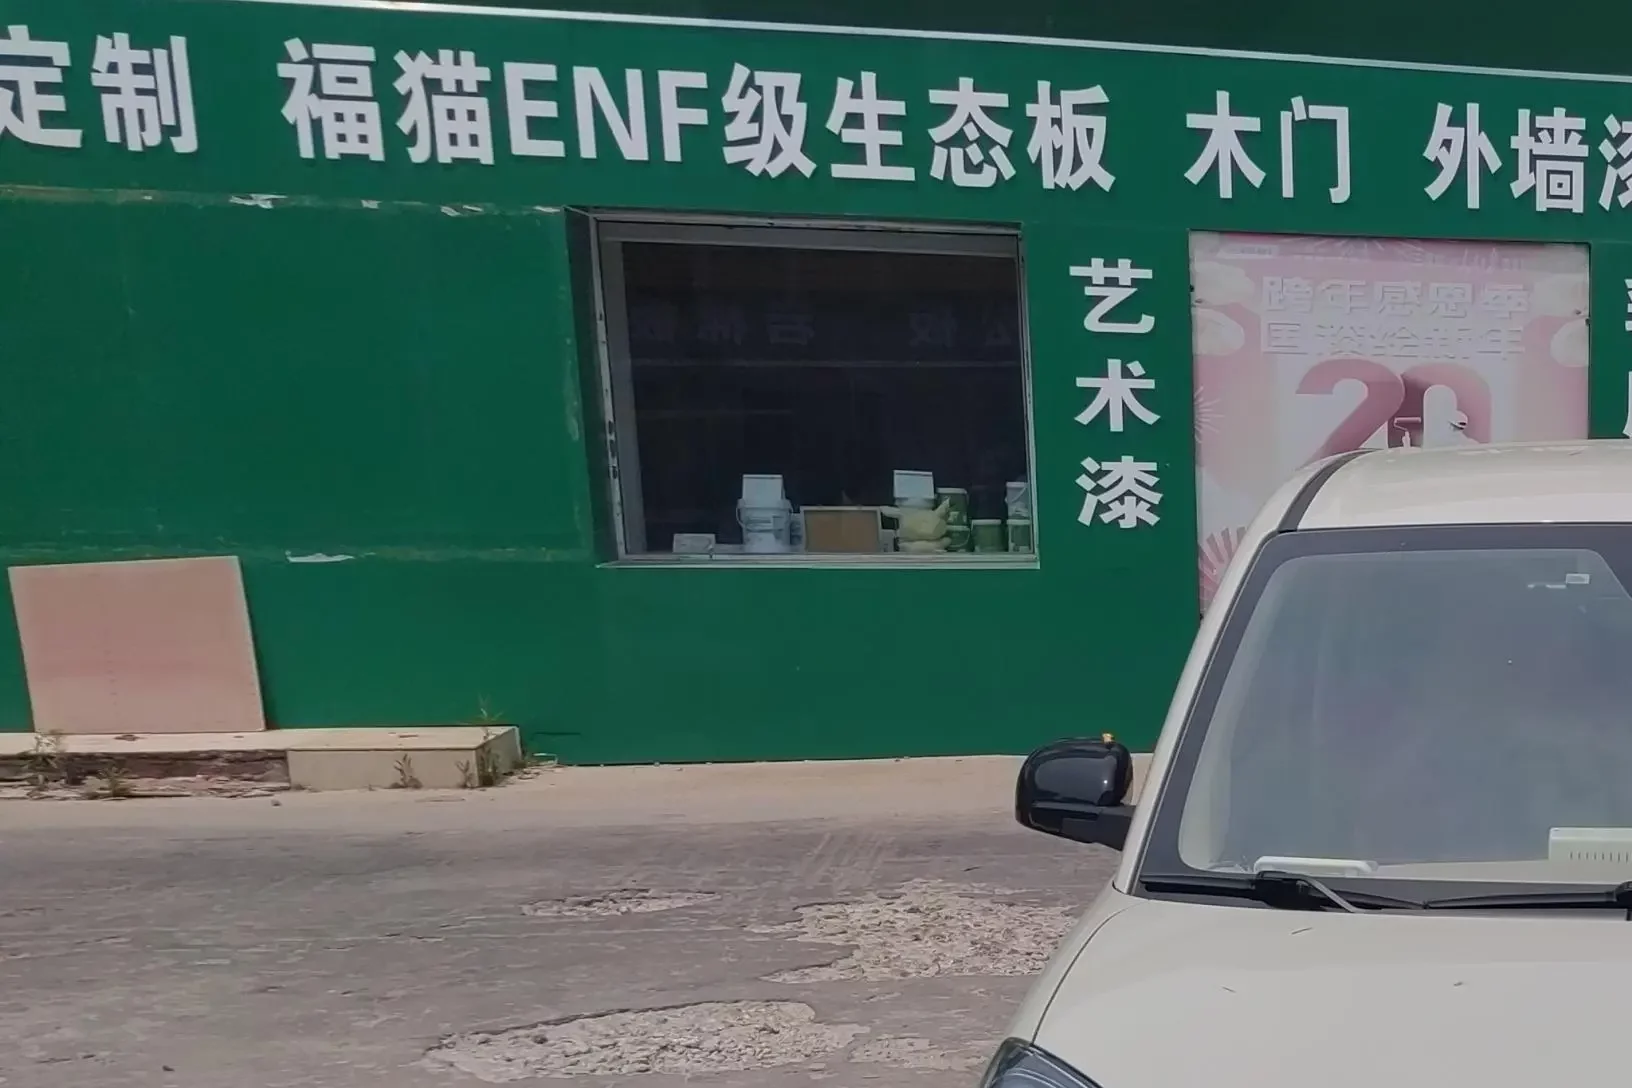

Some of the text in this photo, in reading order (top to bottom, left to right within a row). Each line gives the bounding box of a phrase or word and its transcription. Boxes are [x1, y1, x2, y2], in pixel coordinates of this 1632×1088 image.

[0, 26, 198, 153] 定制
[277, 36, 1116, 193] 福猫ENF级生态板
[1185, 91, 1351, 204] 木门
[1262, 276, 1531, 319] 跨年感恩季
[1069, 257, 1163, 529] 艺术漆
